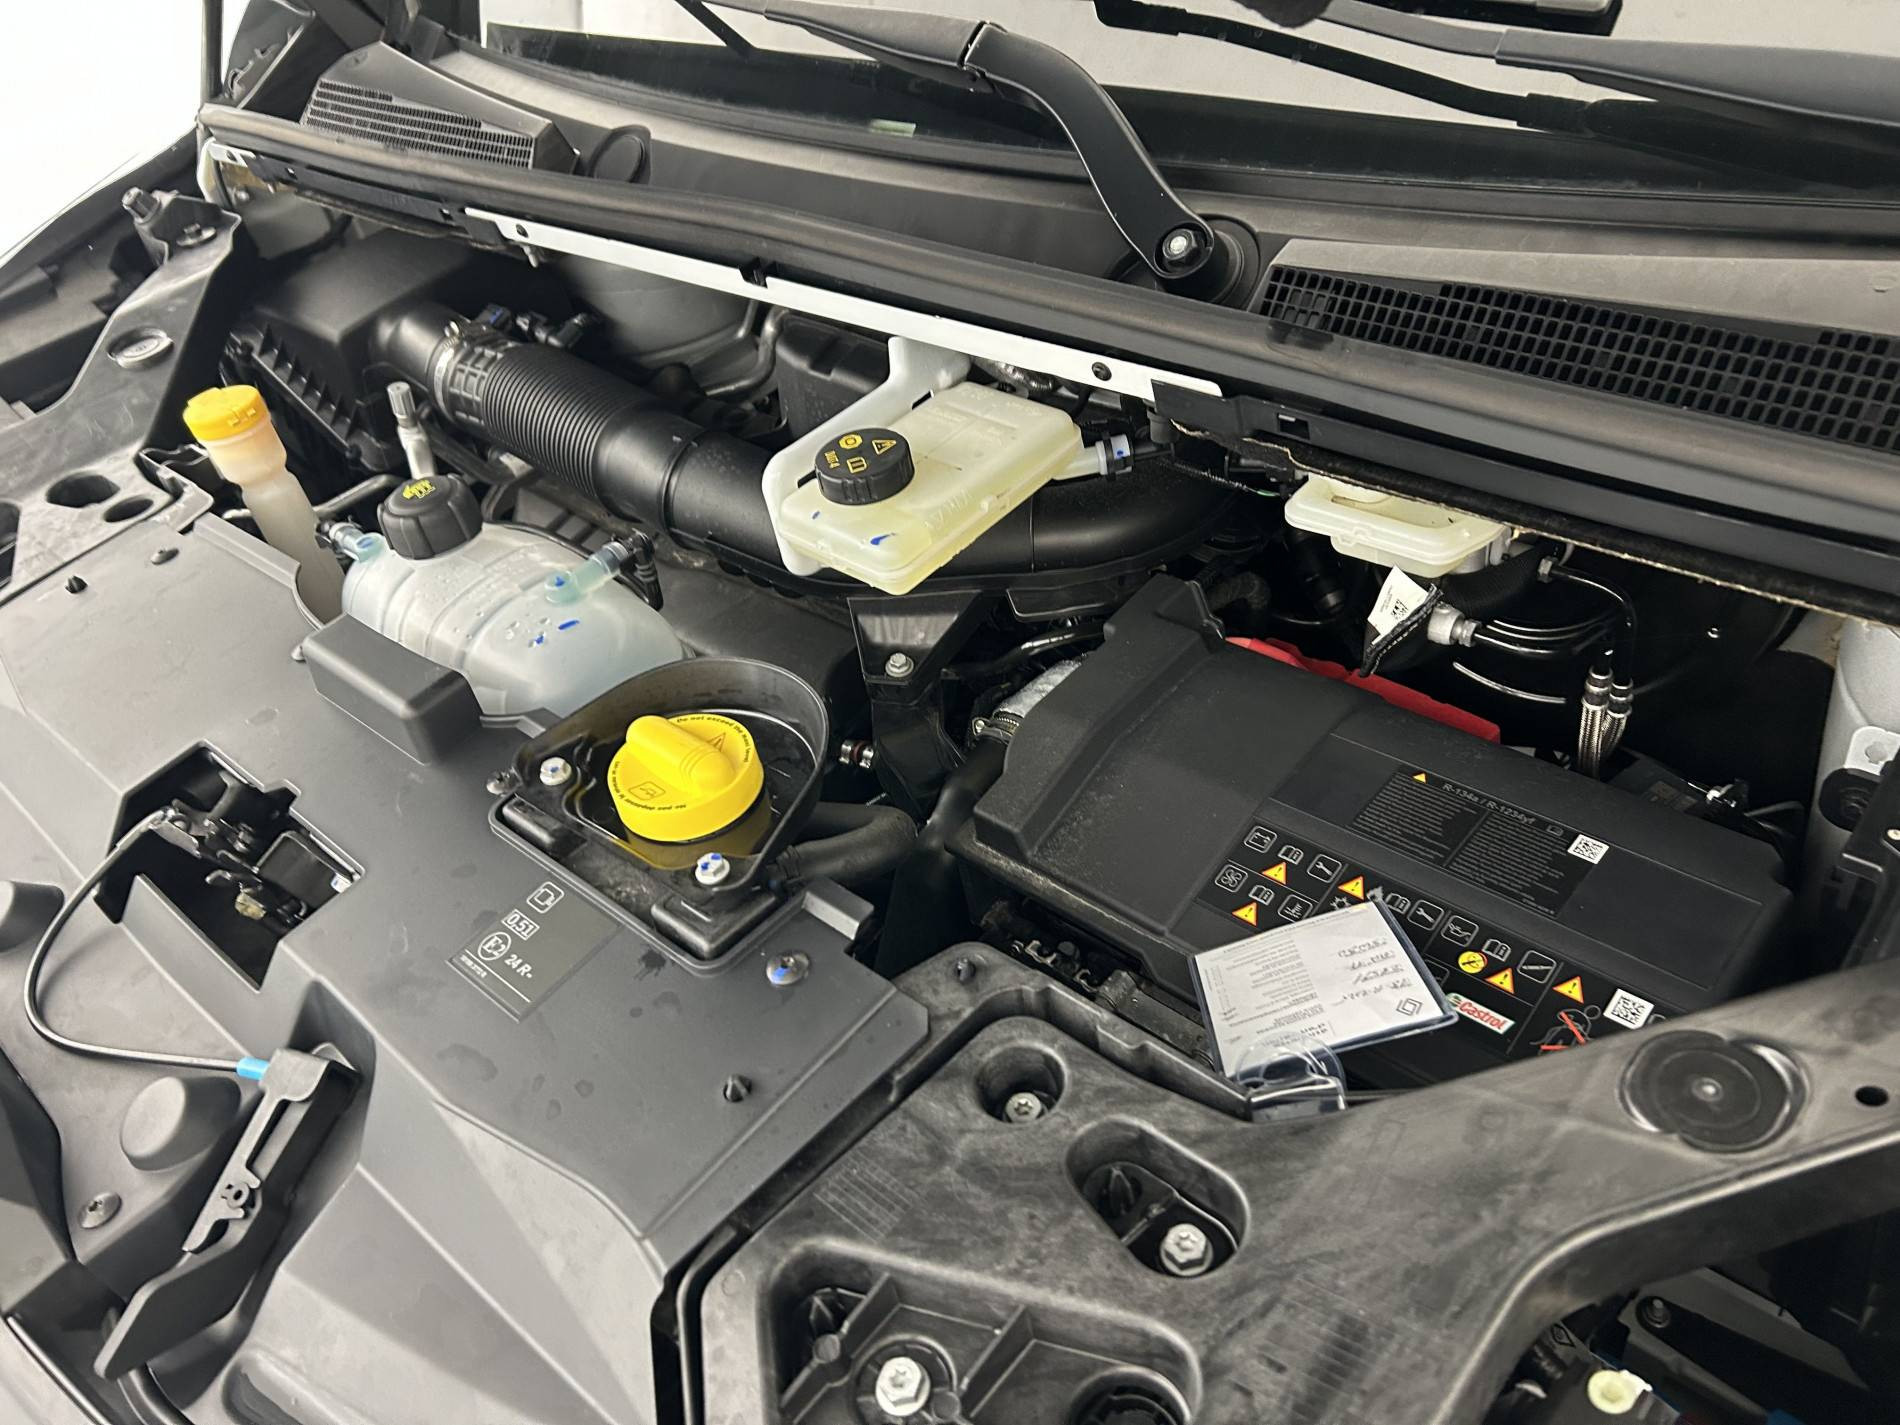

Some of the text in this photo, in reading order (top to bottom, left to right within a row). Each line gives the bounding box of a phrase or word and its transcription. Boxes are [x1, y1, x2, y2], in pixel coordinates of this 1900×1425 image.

[1442, 783, 1479, 802] R-134a
[1486, 801, 1536, 824] R-1234yf
[482, 935, 506, 957] E2
[1460, 1002, 1508, 1029] Castrol
